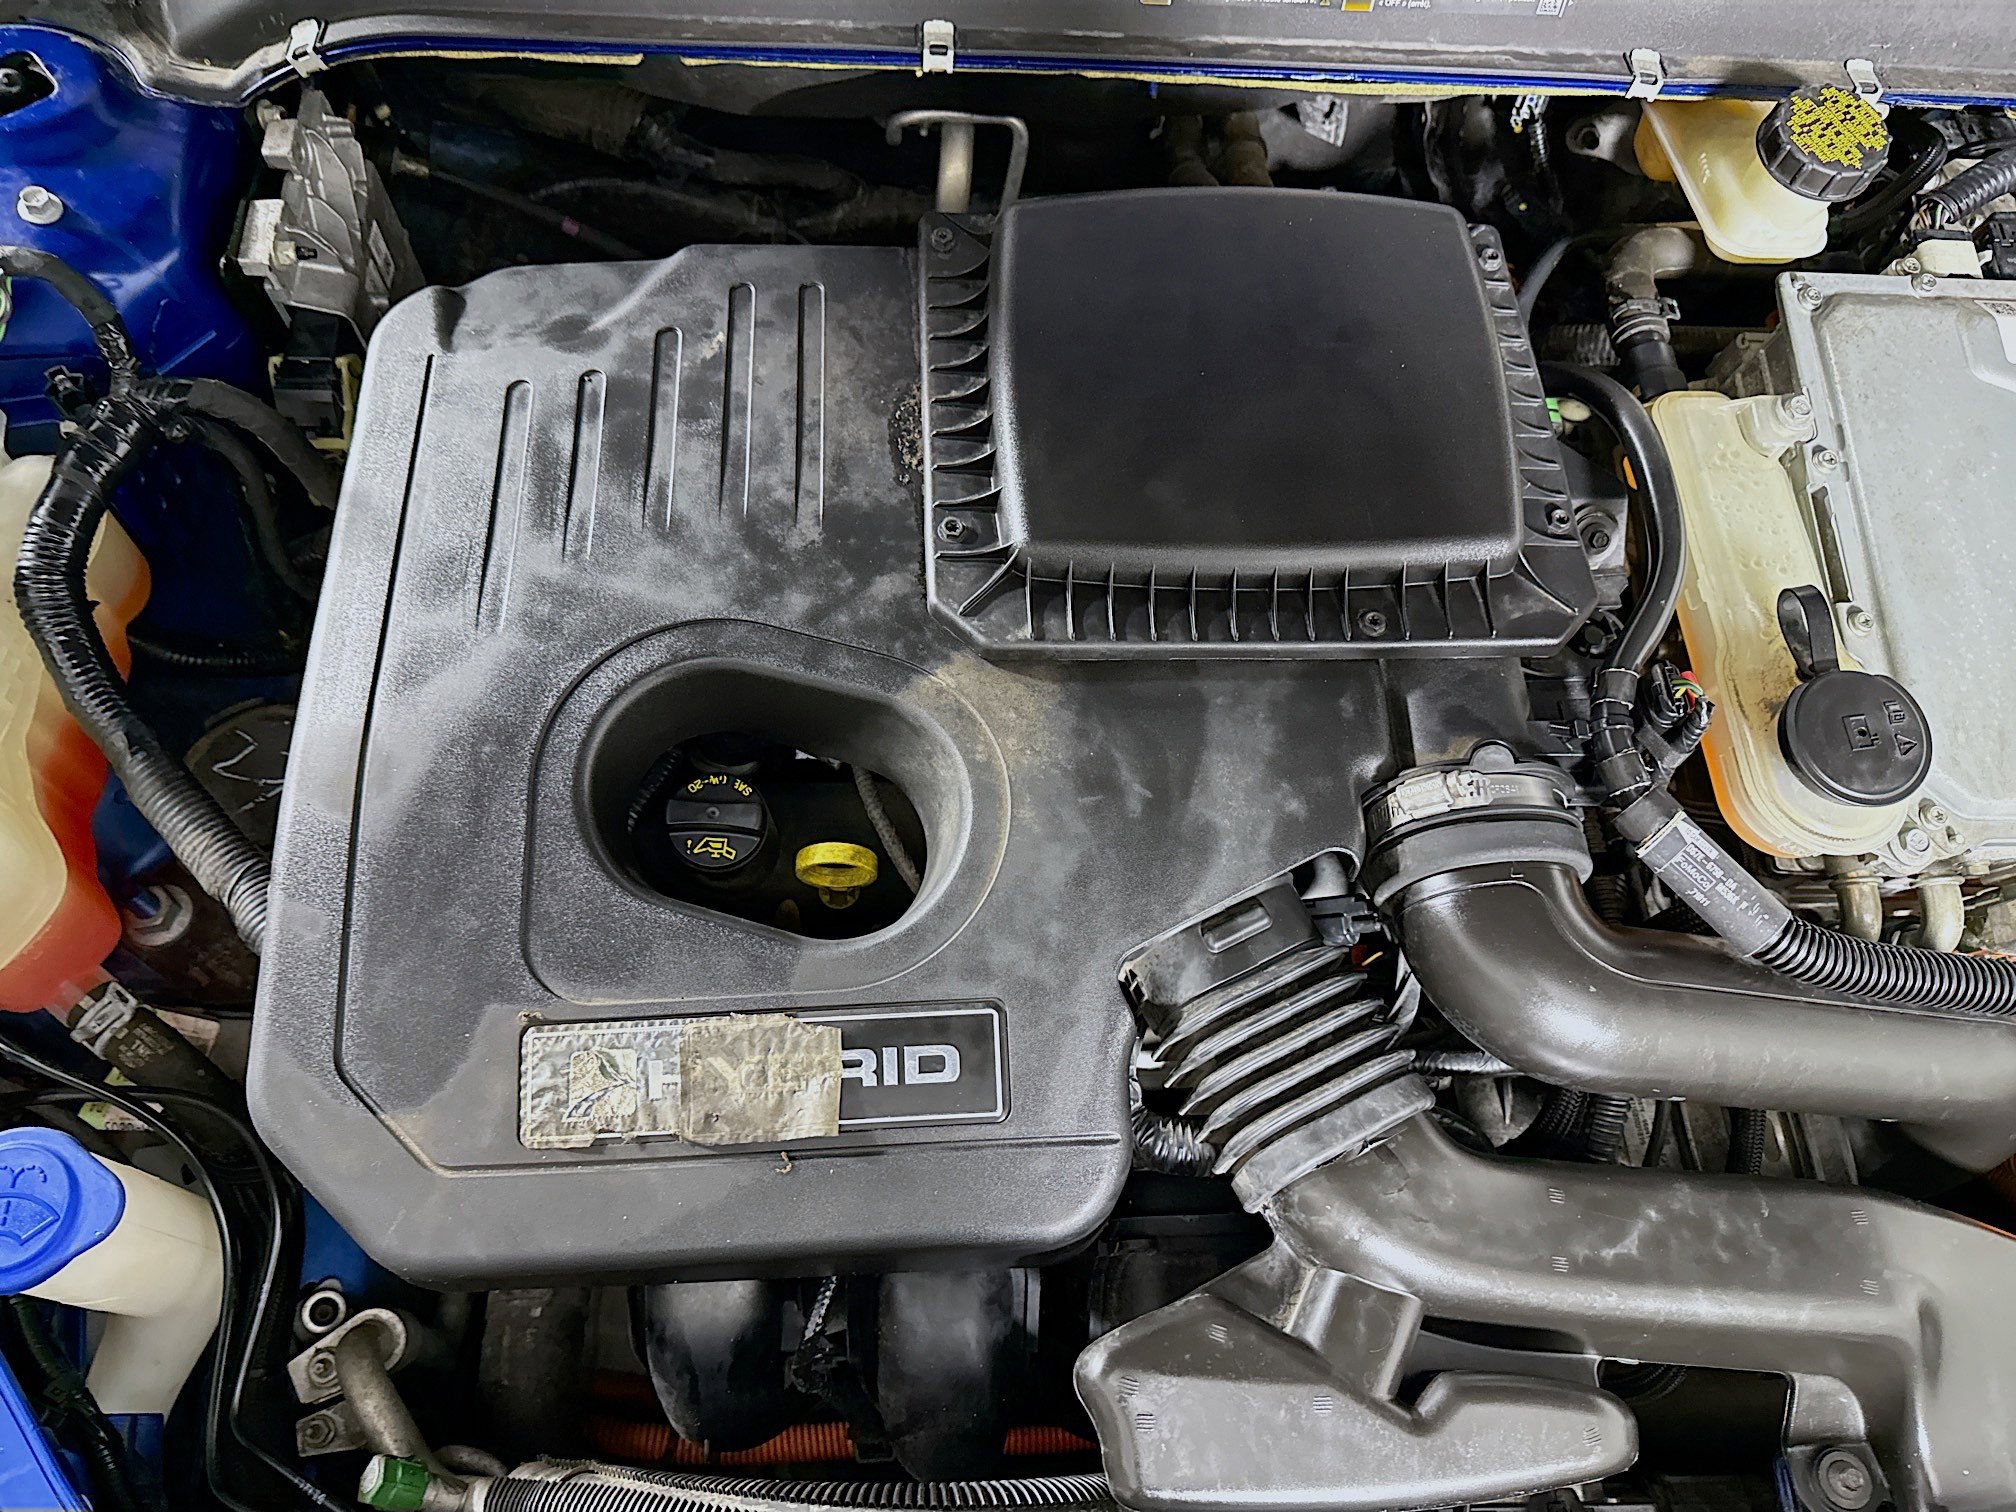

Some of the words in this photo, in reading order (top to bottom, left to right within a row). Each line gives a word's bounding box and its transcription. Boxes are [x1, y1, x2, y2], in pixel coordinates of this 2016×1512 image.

[1789, 104, 1813, 125] PLOYER
[1809, 124, 1824, 136] QUE
[1820, 136, 1832, 146] DU
[1790, 95, 1811, 112] AVANT
[1807, 112, 1818, 121] DE
[1815, 121, 1826, 129] LE
[1790, 114, 1805, 126] DOT
[1803, 98, 1831, 124] NETTOYER
[1828, 125, 1839, 133] LE
[1819, 88, 1838, 103] ONLY
[1834, 102, 1848, 114] DOT
[1850, 119, 1869, 135] FLUID
[1865, 135, 1884, 152] FROM
[1823, 100, 1845, 120] SEALED
[1828, 86, 1850, 106] BEFORE
[1874, 134, 1888, 146] USE
[1840, 89, 1859, 106] CLEAN
[1856, 107, 1876, 125] FILLER
[1874, 124, 1888, 136] CAP
[734, 778, 752, 796] SAE
[1674, 856, 1711, 890] FoMoCo
